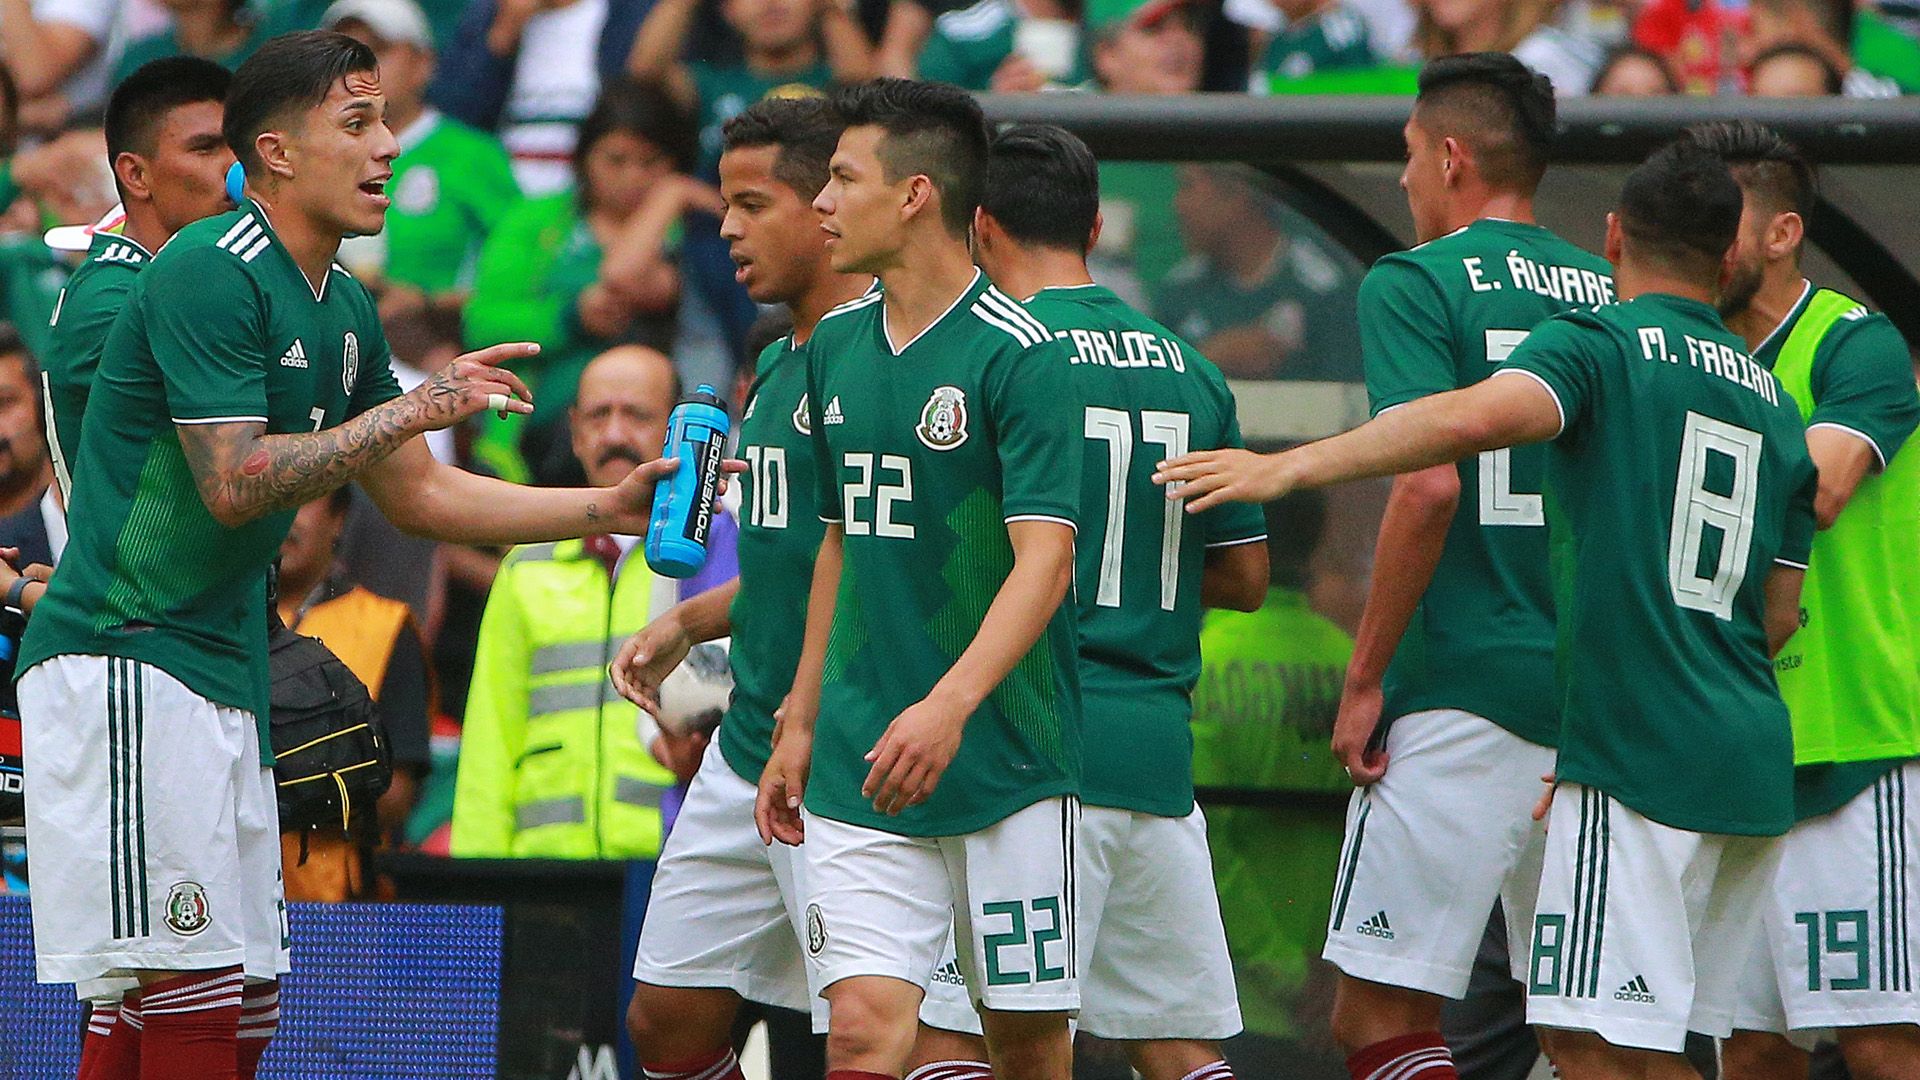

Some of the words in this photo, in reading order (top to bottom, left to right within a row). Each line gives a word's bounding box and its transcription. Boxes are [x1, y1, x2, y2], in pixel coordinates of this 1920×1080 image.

[1463, 256, 1501, 292] E.
[1506, 249, 1621, 305] ÁLVARE
[280, 356, 308, 369] adidas
[1637, 327, 1678, 364] M.
[694, 433, 723, 543] POWERADE
[746, 446, 788, 528] 10
[844, 453, 915, 539] 22
[1668, 410, 1763, 621] 8
[983, 896, 1065, 986] 22
[1356, 925, 1395, 940] adidas
[1529, 914, 1566, 996] 8
[1795, 910, 1870, 991] 19
[931, 972, 965, 986] adida
[1613, 990, 1656, 1004] adidas
